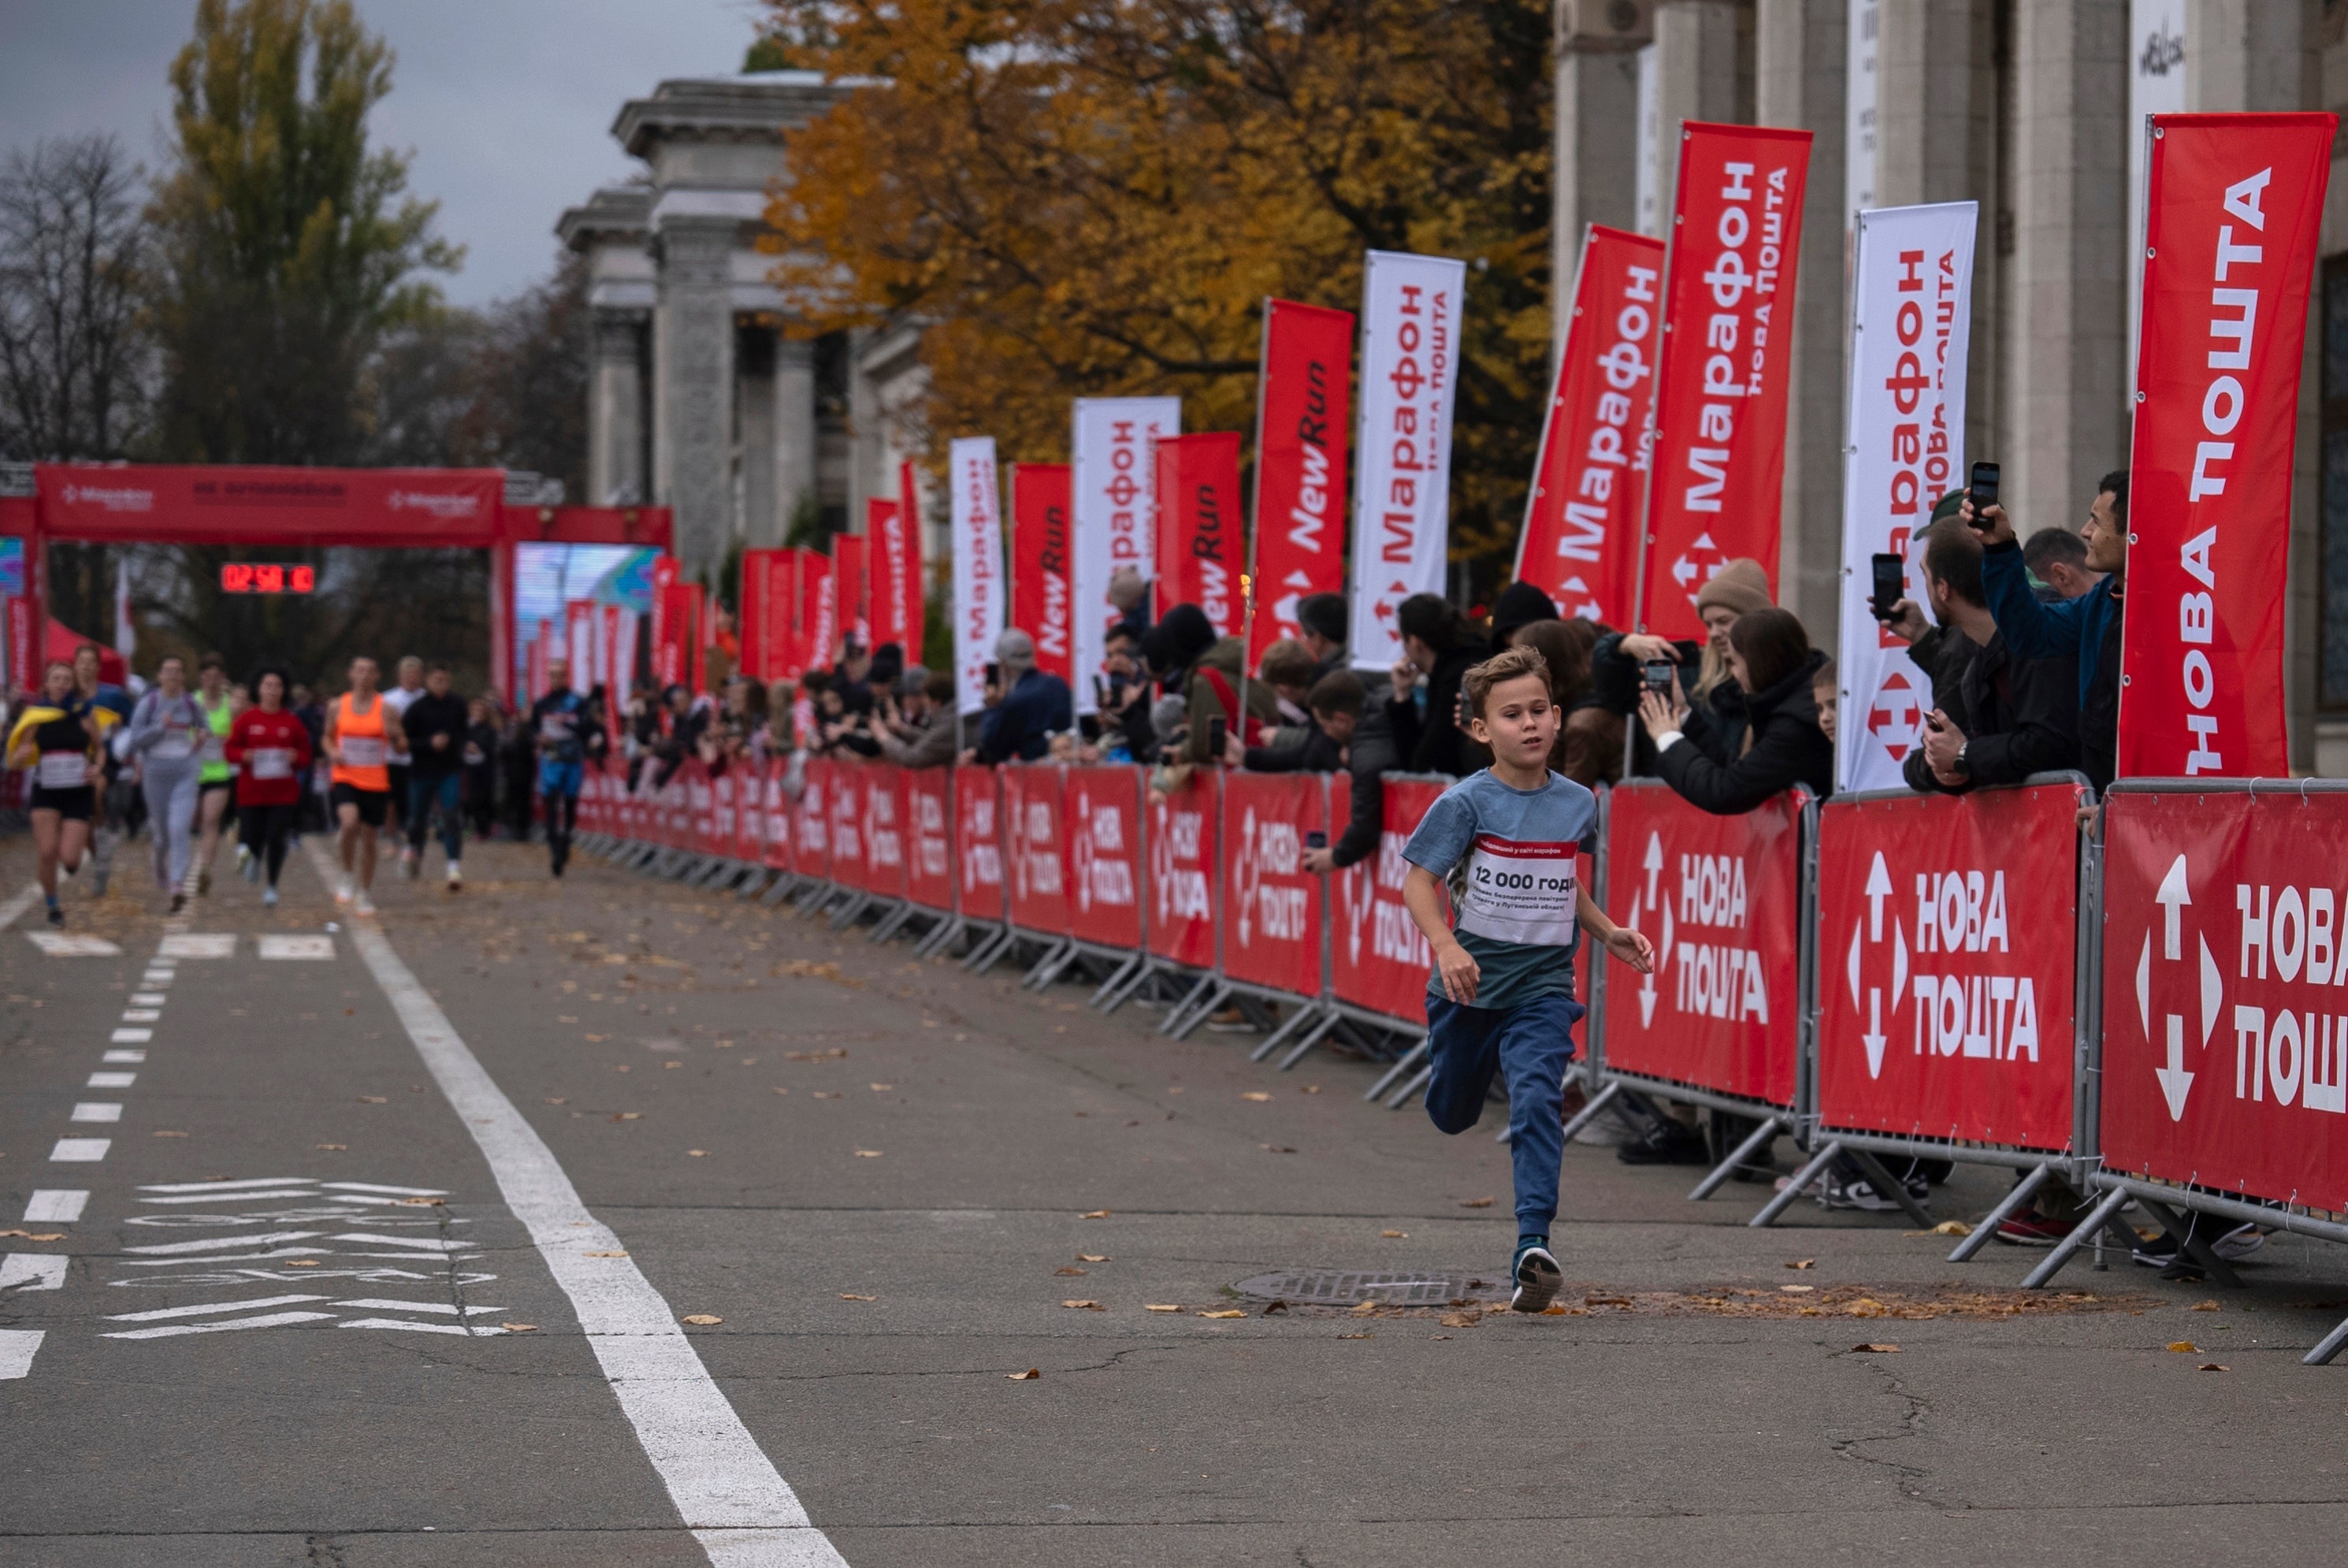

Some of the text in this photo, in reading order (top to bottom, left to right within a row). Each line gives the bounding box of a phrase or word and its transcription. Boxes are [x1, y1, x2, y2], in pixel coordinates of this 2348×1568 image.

[1431, 291, 1447, 392] ПОШТА
[1685, 161, 1755, 513] Марафон
[1747, 166, 1789, 397] НОВА ПОШТА
[1287, 360, 1328, 553] NewRun
[1381, 285, 1425, 563] Марафон
[1557, 265, 1658, 563] Марафон
[1632, 396, 1655, 470] НО
[1879, 250, 1930, 648] арафон
[2181, 165, 2272, 775] НОВА ПОШТА
[968, 459, 990, 641] Марафон
[1037, 505, 1067, 658] NewRun
[1105, 422, 1140, 629] рафон
[1191, 484, 1229, 637] ewRun
[1475, 865, 1576, 893] 12 000 годи
[1680, 853, 1747, 929] НОВА
[1916, 869, 2010, 953] НОВА
[1677, 942, 1769, 1025] ПОШТА
[1913, 975, 2039, 1063] ПОШТА
